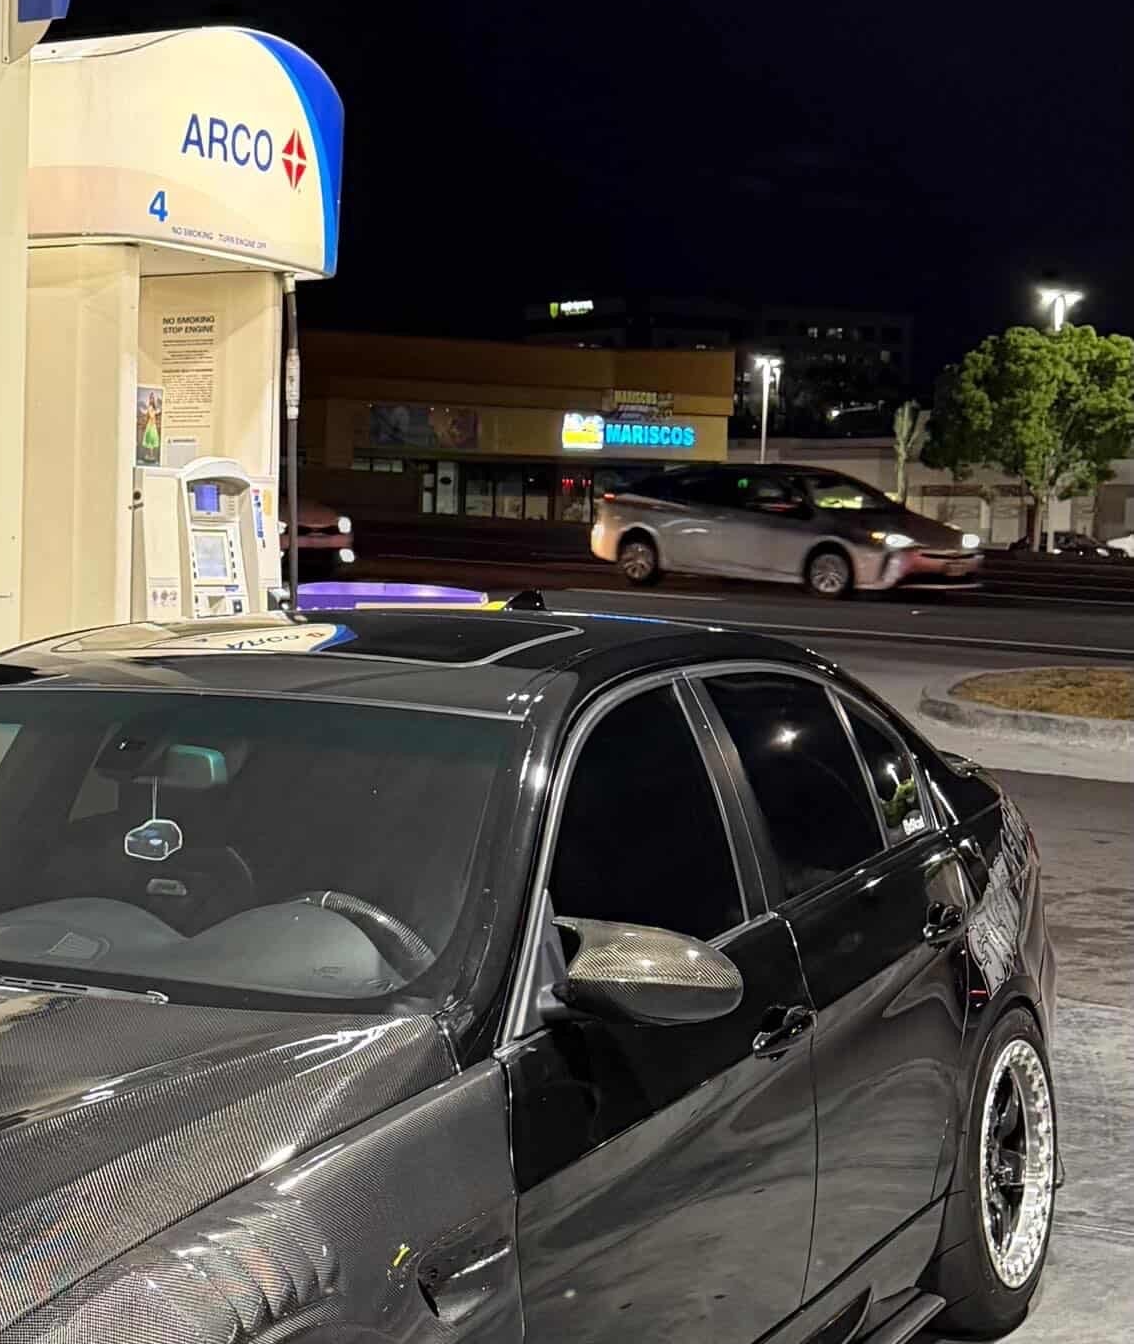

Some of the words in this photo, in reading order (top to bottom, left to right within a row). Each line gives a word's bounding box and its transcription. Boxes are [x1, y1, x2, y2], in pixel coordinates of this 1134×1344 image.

[181, 113, 273, 172] ARCO
[148, 190, 168, 223] 4
[162, 316, 175, 325] NO
[177, 315, 215, 324] SMOKING
[163, 326, 183, 334] STOP
[185, 325, 214, 333] ENGINE
[605, 424, 695, 446] MARISCOS
